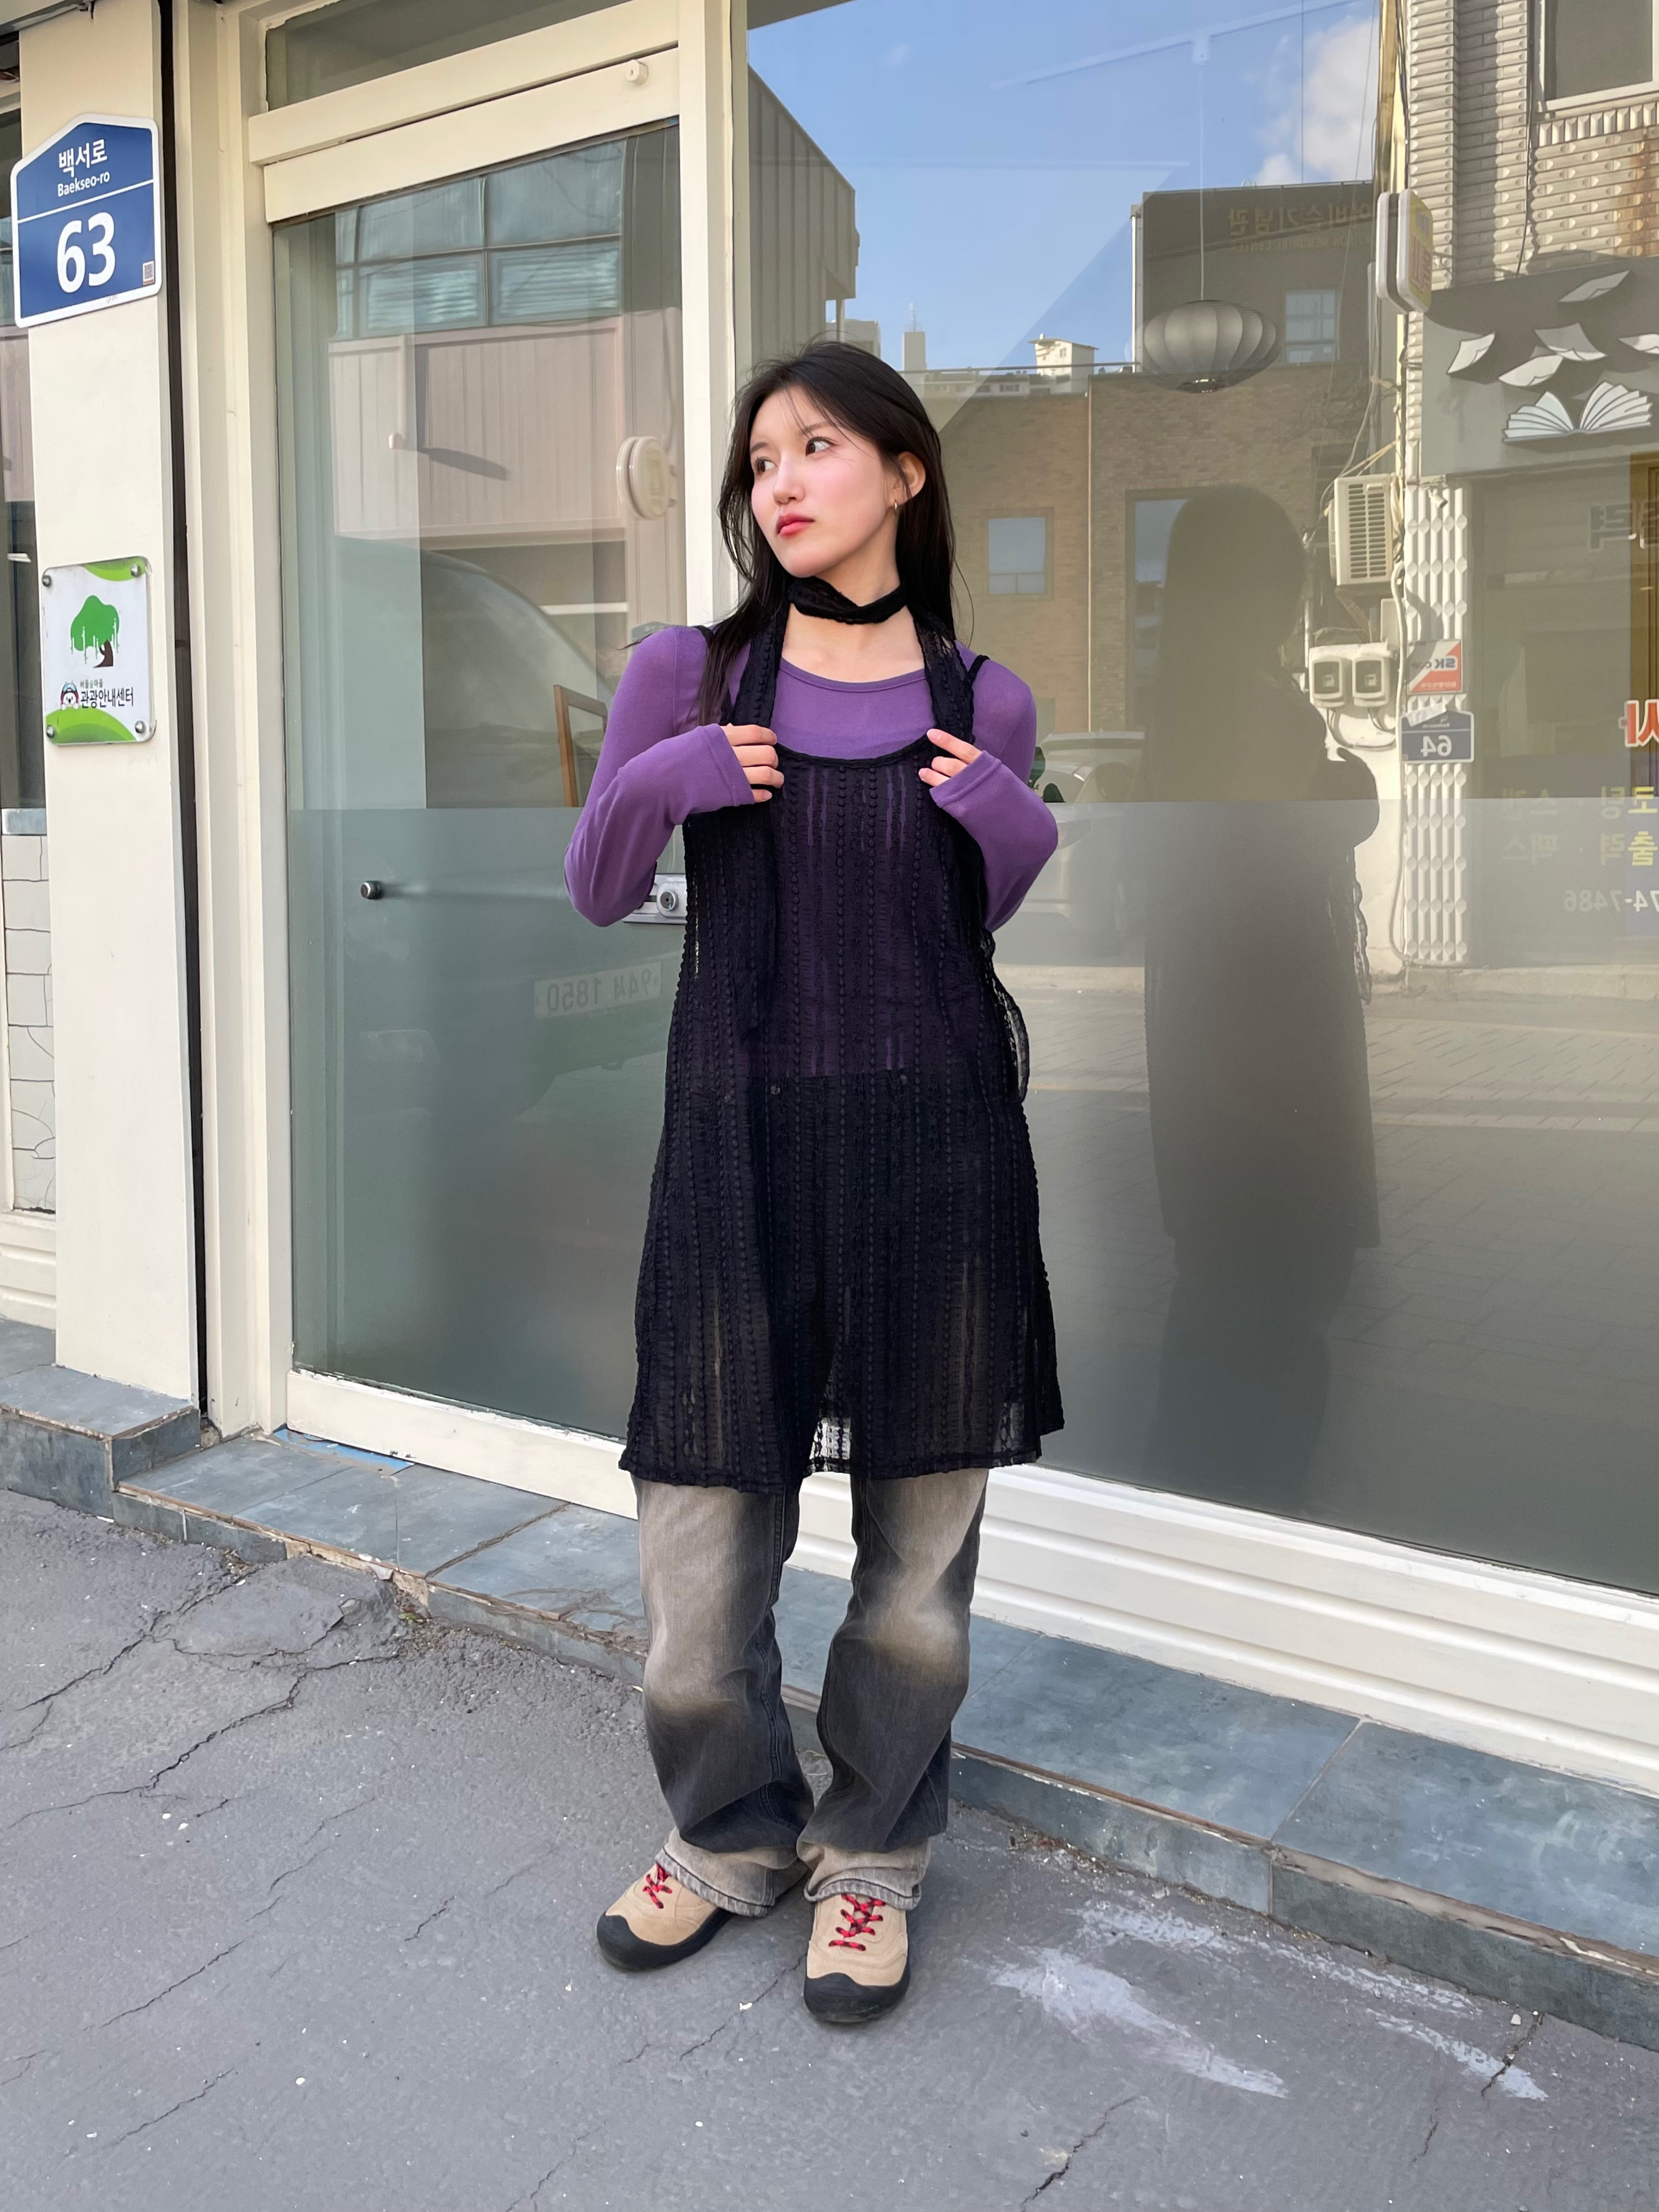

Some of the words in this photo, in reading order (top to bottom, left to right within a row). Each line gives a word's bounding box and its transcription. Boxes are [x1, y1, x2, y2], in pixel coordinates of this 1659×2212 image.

[59, 138, 108, 177] 백서로
[57, 171, 110, 197] Baekseo-ro
[57, 212, 116, 293] 63
[80, 686, 134, 709] 관광안내센터
